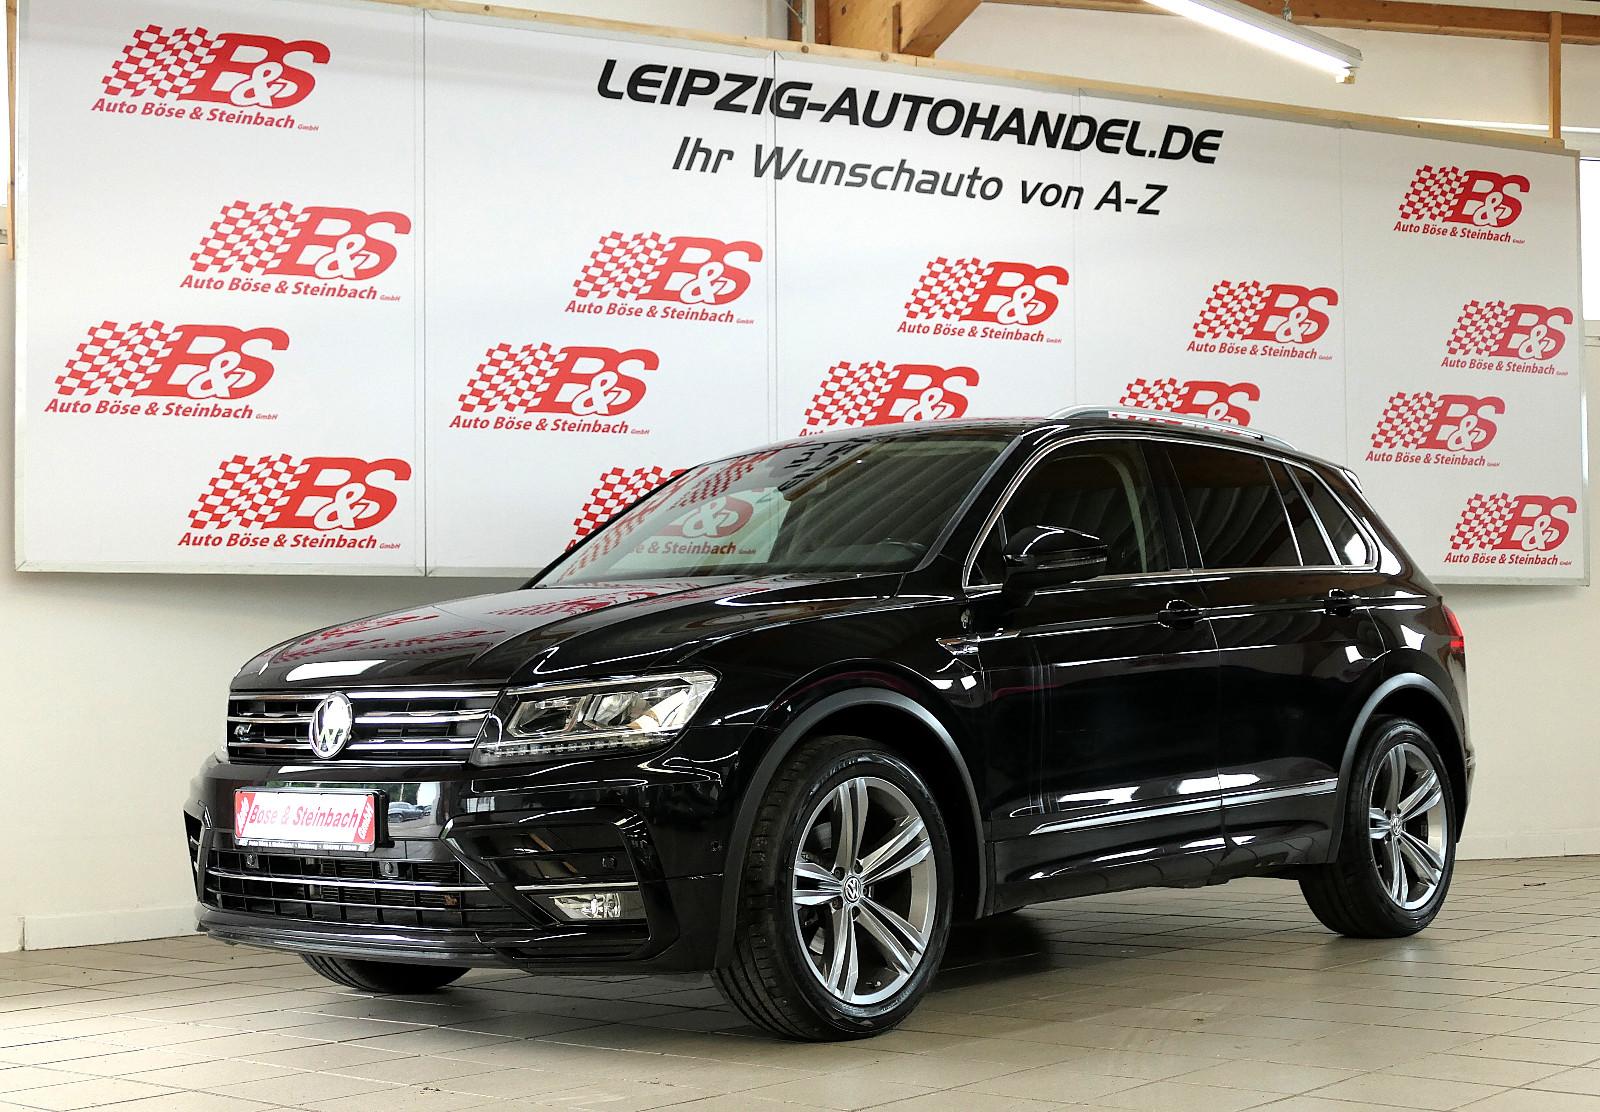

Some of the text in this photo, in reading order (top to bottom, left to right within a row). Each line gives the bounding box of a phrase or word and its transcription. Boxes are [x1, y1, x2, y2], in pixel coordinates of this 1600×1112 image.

[91, 98, 137, 115] Auto
[141, 101, 186, 119] Böse
[189, 105, 204, 121] &
[206, 108, 296, 129] Steinbach
[597, 59, 1225, 165] LEIPZIG-AUTOHANDEL.DE
[672, 136, 1169, 216] Ihr Wunschauto von A-Z
[1393, 220, 1420, 234] Auto
[1422, 223, 1449, 237] Böse
[1449, 226, 1459, 238] &
[1460, 227, 1512, 244] Steinbach
[180, 273, 224, 290] Auto
[228, 276, 271, 293] Böse
[274, 279, 290, 295] &
[291, 281, 377, 301] Steinbach
[565, 299, 603, 315] Auto
[606, 302, 643, 318] Böse
[646, 305, 659, 319] &
[660, 306, 735, 324] Steinbach
[896, 321, 930, 336] Auto
[933, 322, 965, 338] Böse
[967, 325, 979, 338] &
[979, 326, 1045, 343] Steinbach
[1186, 340, 1217, 353] Auto
[1218, 341, 1247, 356] Böse
[1248, 343, 1259, 356] &
[1260, 344, 1318, 360] Steinbach
[1441, 355, 1467, 370] Auto
[1469, 358, 1494, 372] Böse
[1495, 360, 1505, 373] &
[1506, 361, 1556, 376] Steinbach
[44, 397, 92, 414] Auto
[95, 399, 141, 416] Böse
[144, 401, 161, 417] &
[162, 402, 254, 420] Steinbach
[449, 414, 490, 431] Auto
[493, 415, 532, 432] Böse
[535, 417, 550, 432] &
[550, 418, 630, 435] Steinbach
[1365, 450, 1393, 463] Auto
[1395, 451, 1421, 464] Böse
[1423, 452, 1433, 465] &
[1434, 453, 1486, 467] Steinbach
[177, 531, 223, 548] Auto
[226, 532, 270, 548] Böse
[273, 533, 289, 548] &
[290, 534, 378, 550] Steinbach
[662, 541, 737, 555] Steinbach
[1443, 551, 1470, 564] Auto
[1472, 552, 1497, 565] Böse
[1498, 553, 1508, 565] &
[1508, 553, 1559, 567] Steinbach
[292, 805, 359, 829] Steinbach
